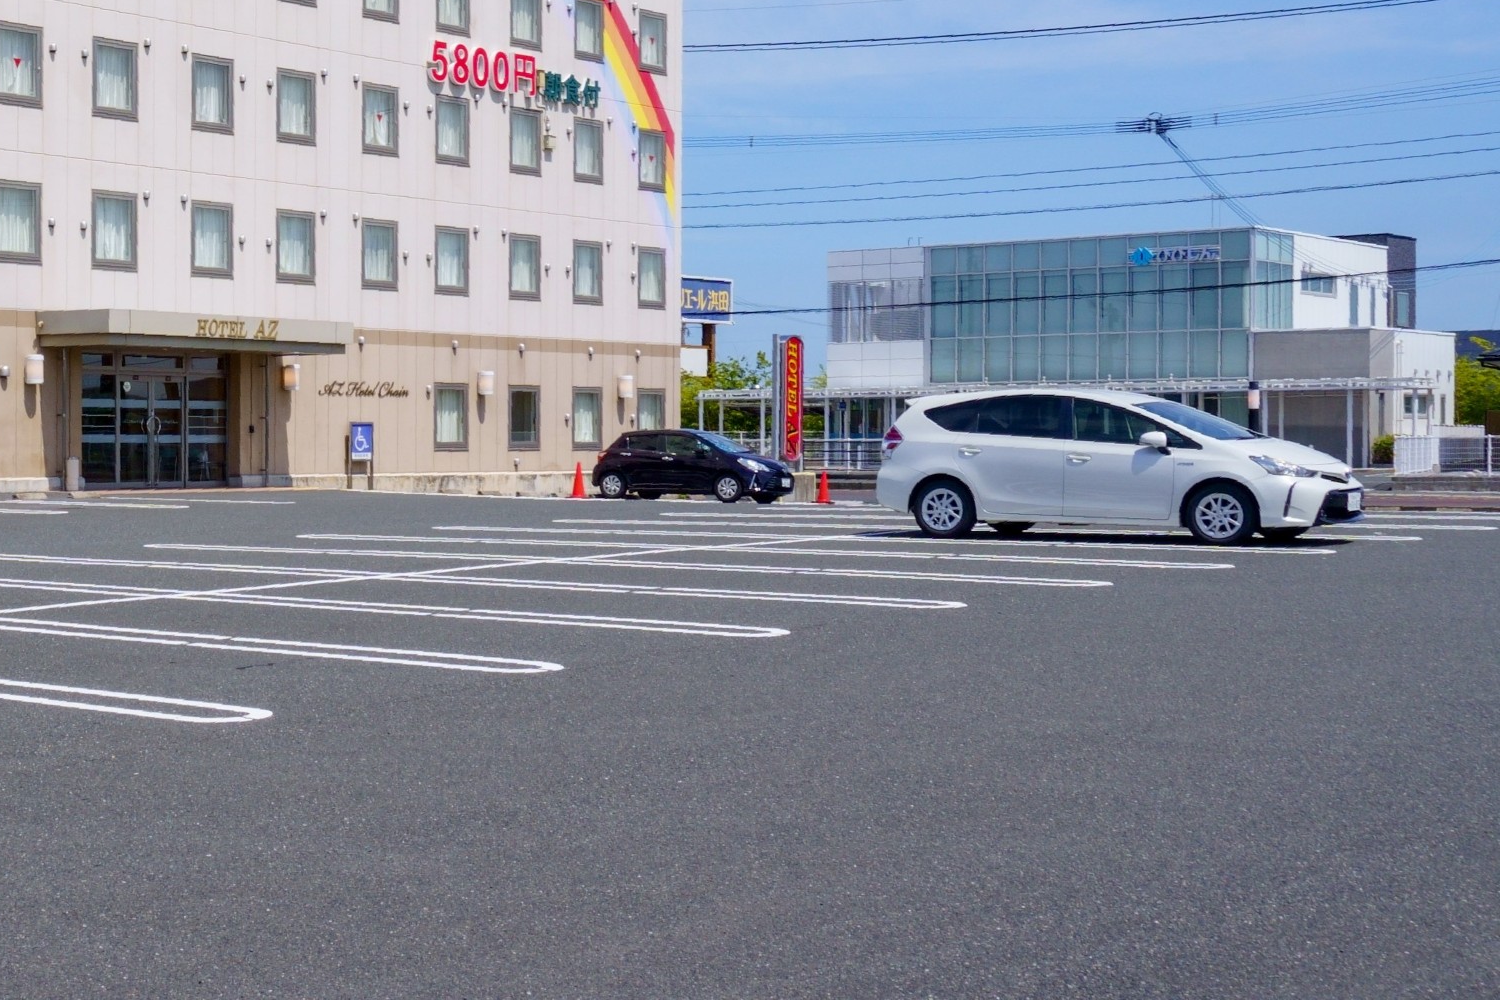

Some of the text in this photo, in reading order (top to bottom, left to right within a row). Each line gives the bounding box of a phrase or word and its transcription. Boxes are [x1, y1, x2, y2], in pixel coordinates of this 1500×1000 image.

[431, 39, 602, 109] 5800円 朝食付
[196, 318, 279, 341] HOTEL AZ
[318, 380, 409, 399] AZ Hotel Chain
[787, 340, 799, 456] HOTEL AZ
